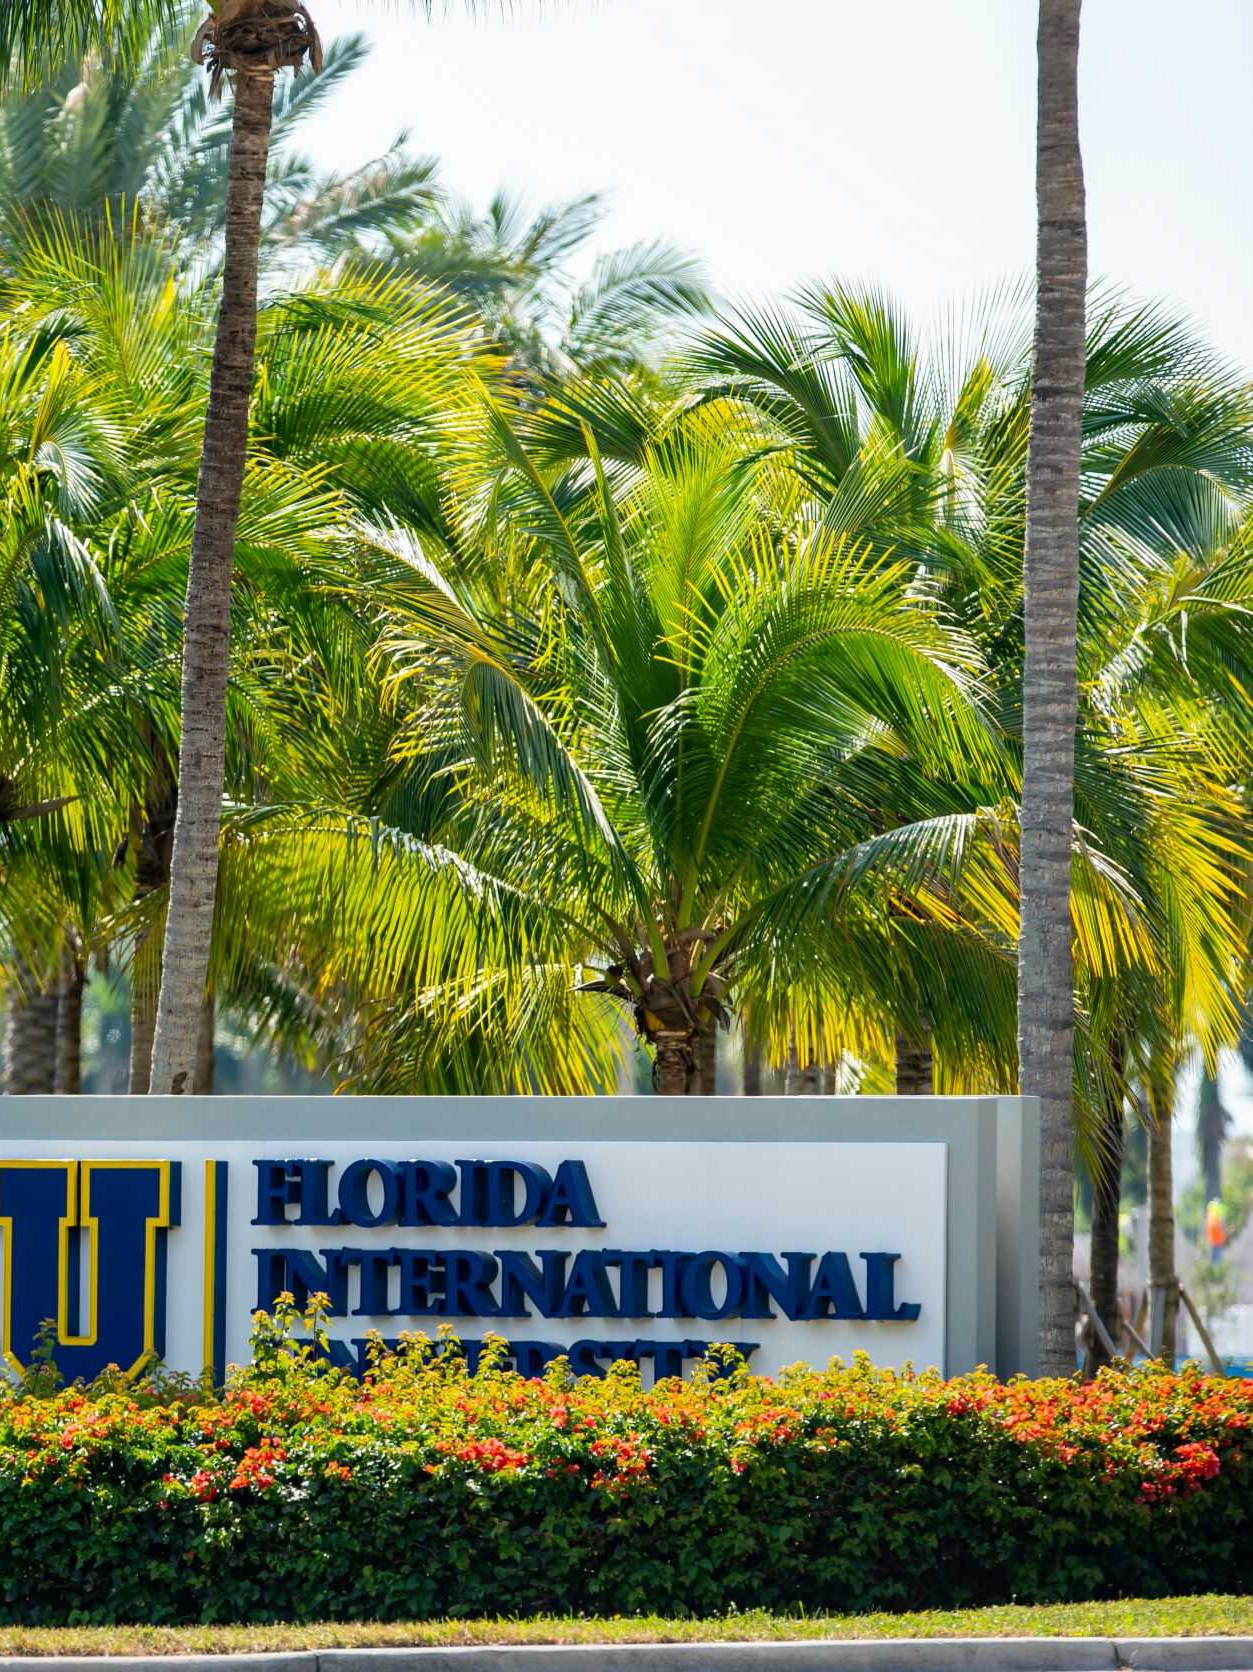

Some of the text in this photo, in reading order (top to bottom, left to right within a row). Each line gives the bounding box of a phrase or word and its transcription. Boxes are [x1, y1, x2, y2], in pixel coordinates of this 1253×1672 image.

[250, 1158, 607, 1228] FLORIDA
[250, 1246, 922, 1321] INTERNATIONAL
[252, 1338, 761, 1385] NRSTY
